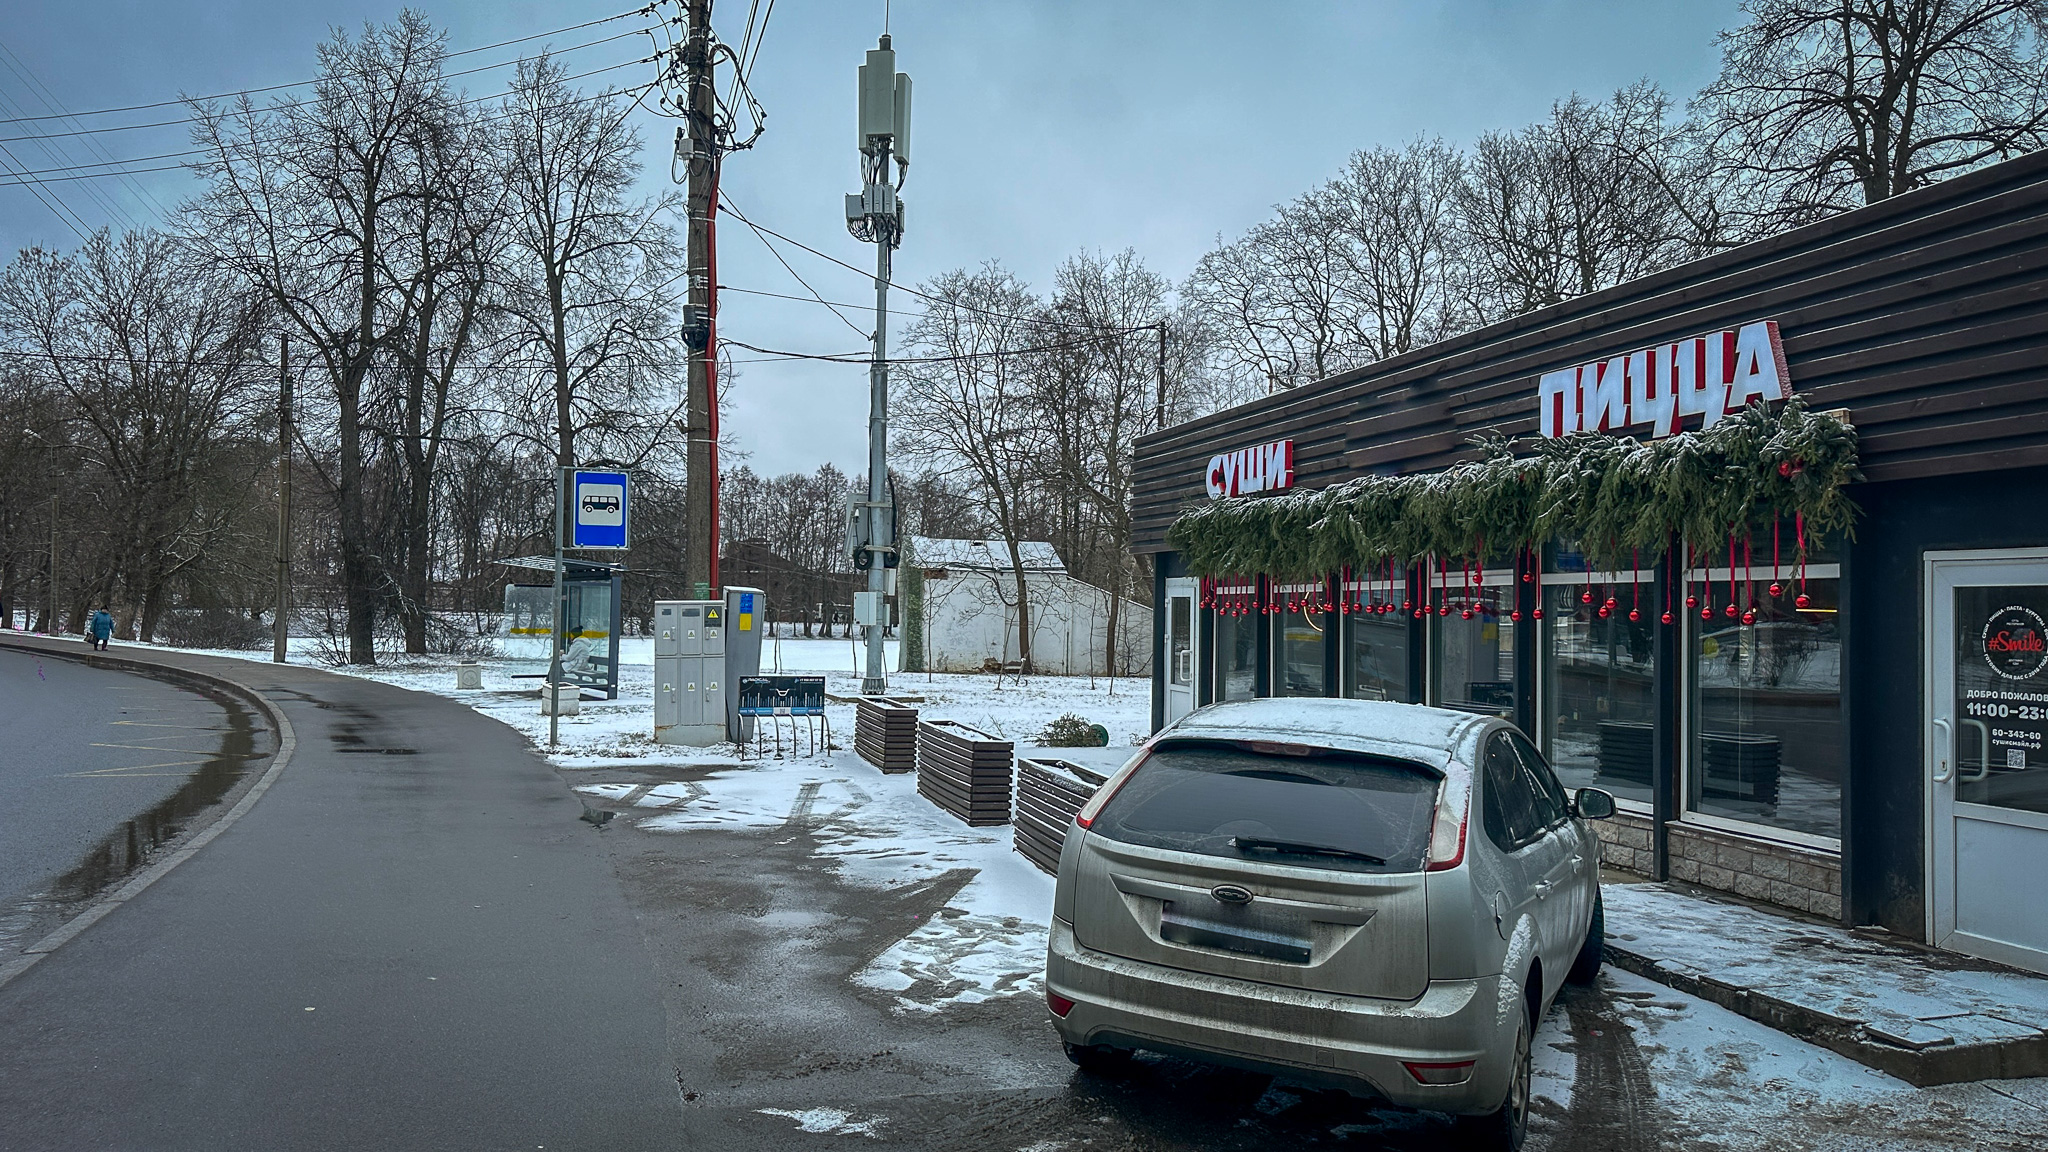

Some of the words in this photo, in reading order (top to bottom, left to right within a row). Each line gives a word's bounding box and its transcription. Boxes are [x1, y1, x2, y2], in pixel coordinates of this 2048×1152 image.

[1538, 321, 1789, 438] ПИЦЦА
[1206, 440, 1291, 500] СУШИ
[1988, 630, 2044, 652] #Smile
[1966, 689, 1999, 699] ДОБРО
[1966, 702, 2048, 720] 11:00-23:
[1992, 728, 2041, 740] 60-343-60
